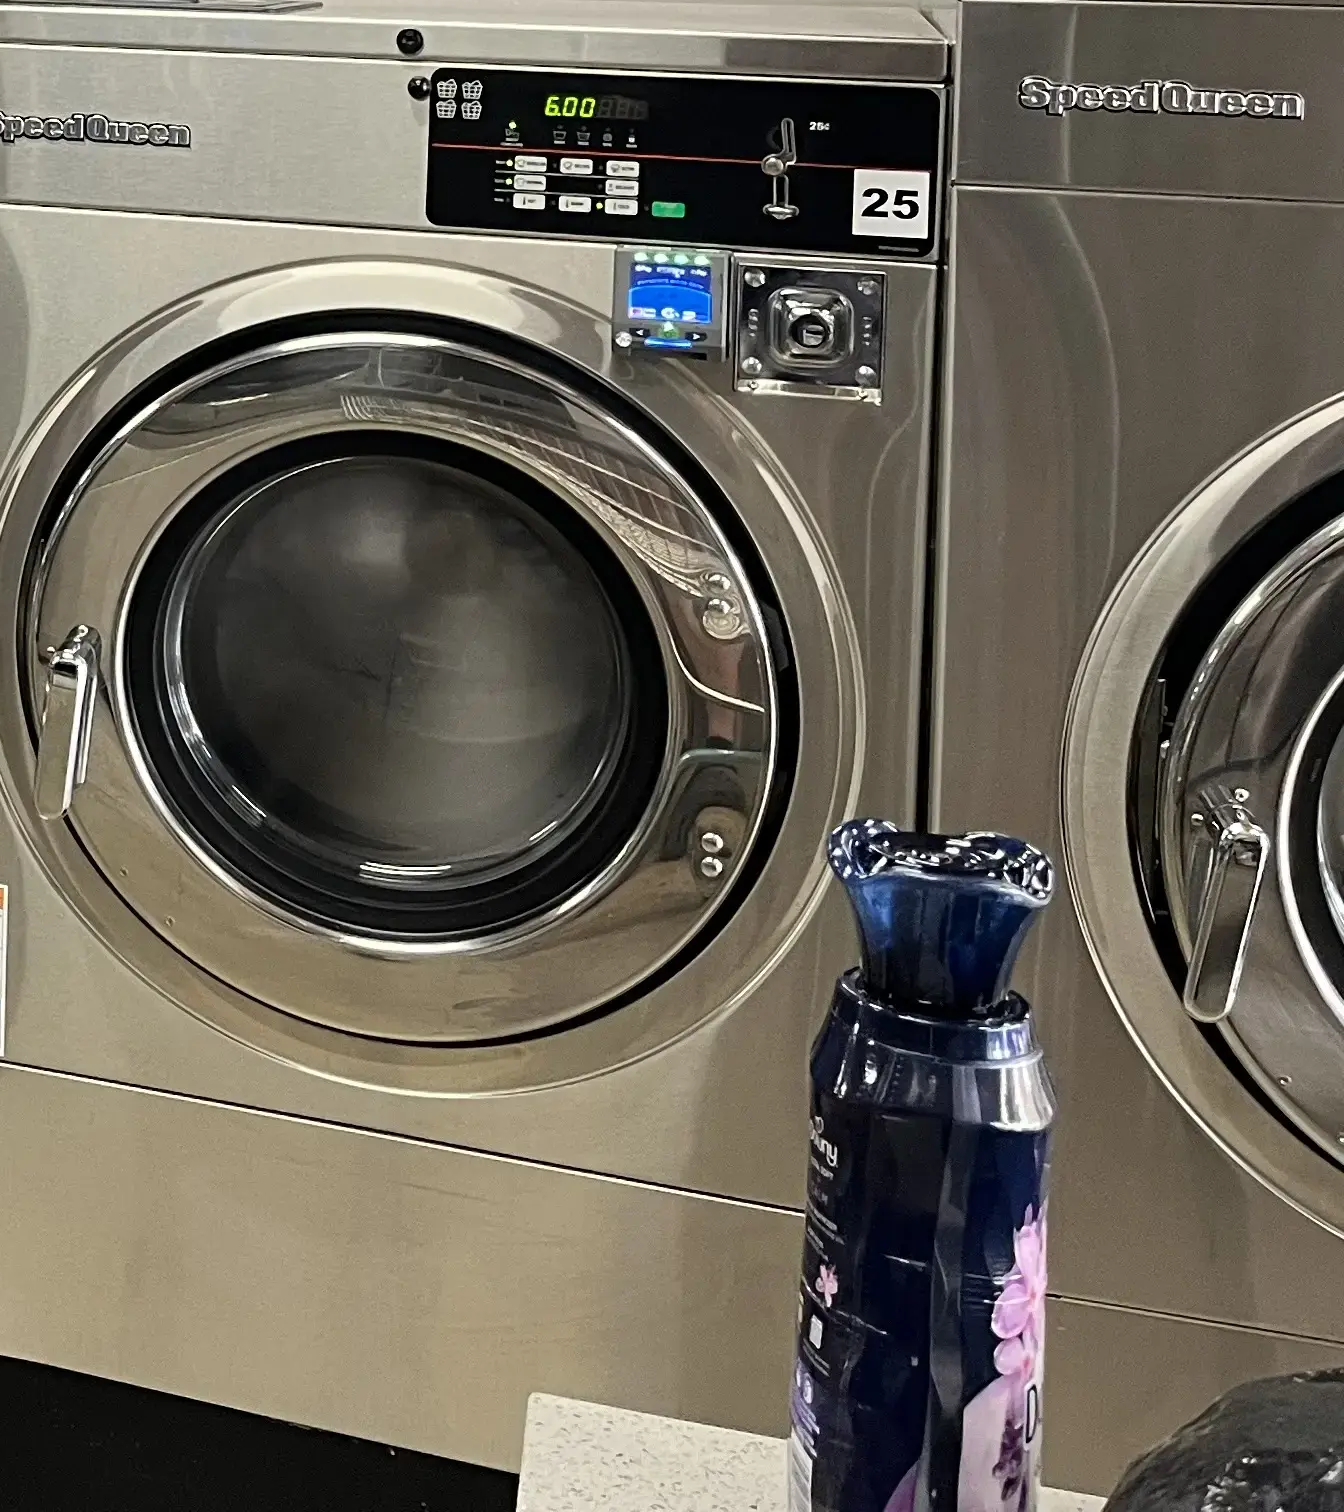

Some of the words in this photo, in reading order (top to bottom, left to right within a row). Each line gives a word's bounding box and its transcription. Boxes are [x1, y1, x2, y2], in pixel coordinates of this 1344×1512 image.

[544, 96, 596, 118] 6.00
[1018, 76, 1161, 116] Speed
[1162, 80, 1305, 120] Queen
[86, 114, 191, 146] Queen
[861, 188, 919, 219] 25
